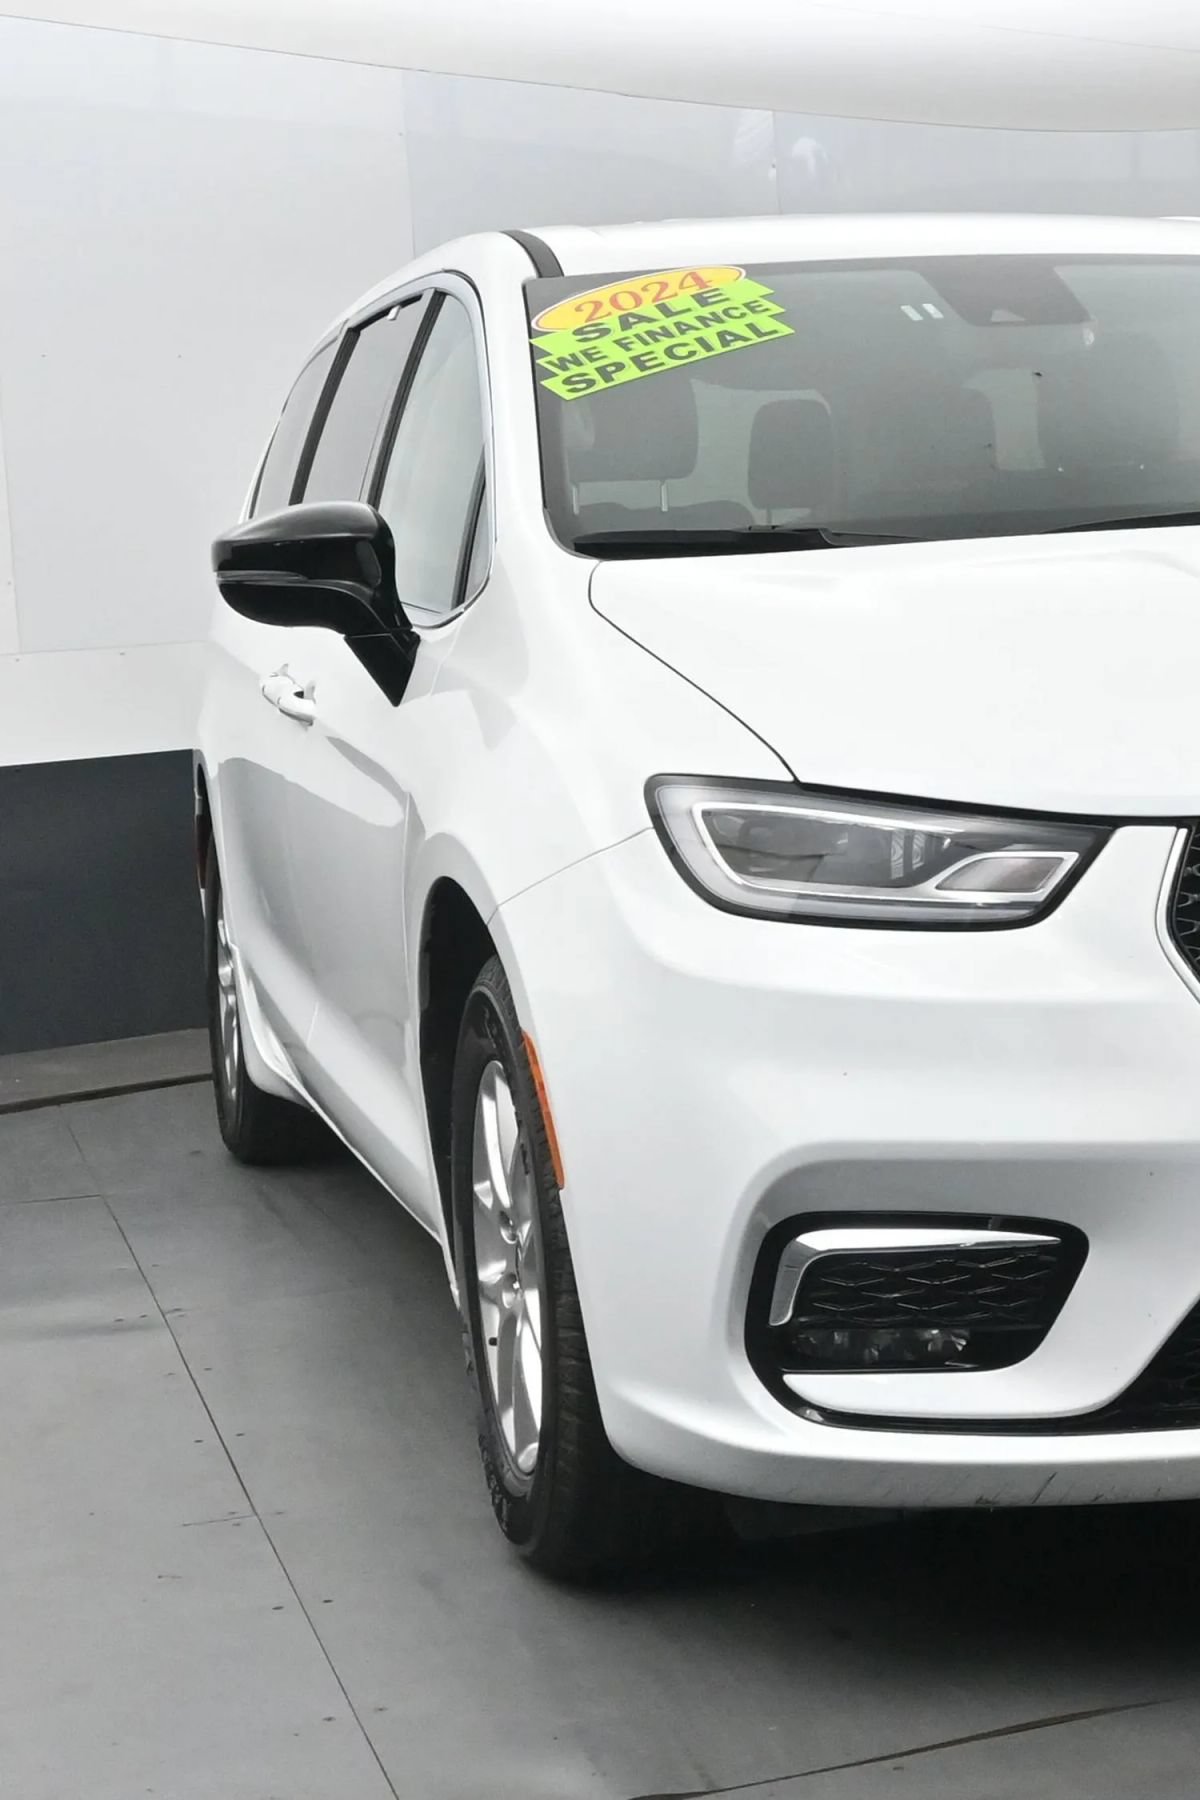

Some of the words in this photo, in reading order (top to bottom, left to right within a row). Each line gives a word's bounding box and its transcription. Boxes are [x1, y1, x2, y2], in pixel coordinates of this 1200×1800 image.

[572, 287, 730, 343] SALE
[574, 271, 713, 323] 2024
[546, 345, 608, 372] WE
[613, 300, 770, 351] FINANCE
[561, 322, 778, 393] SPECIAL
